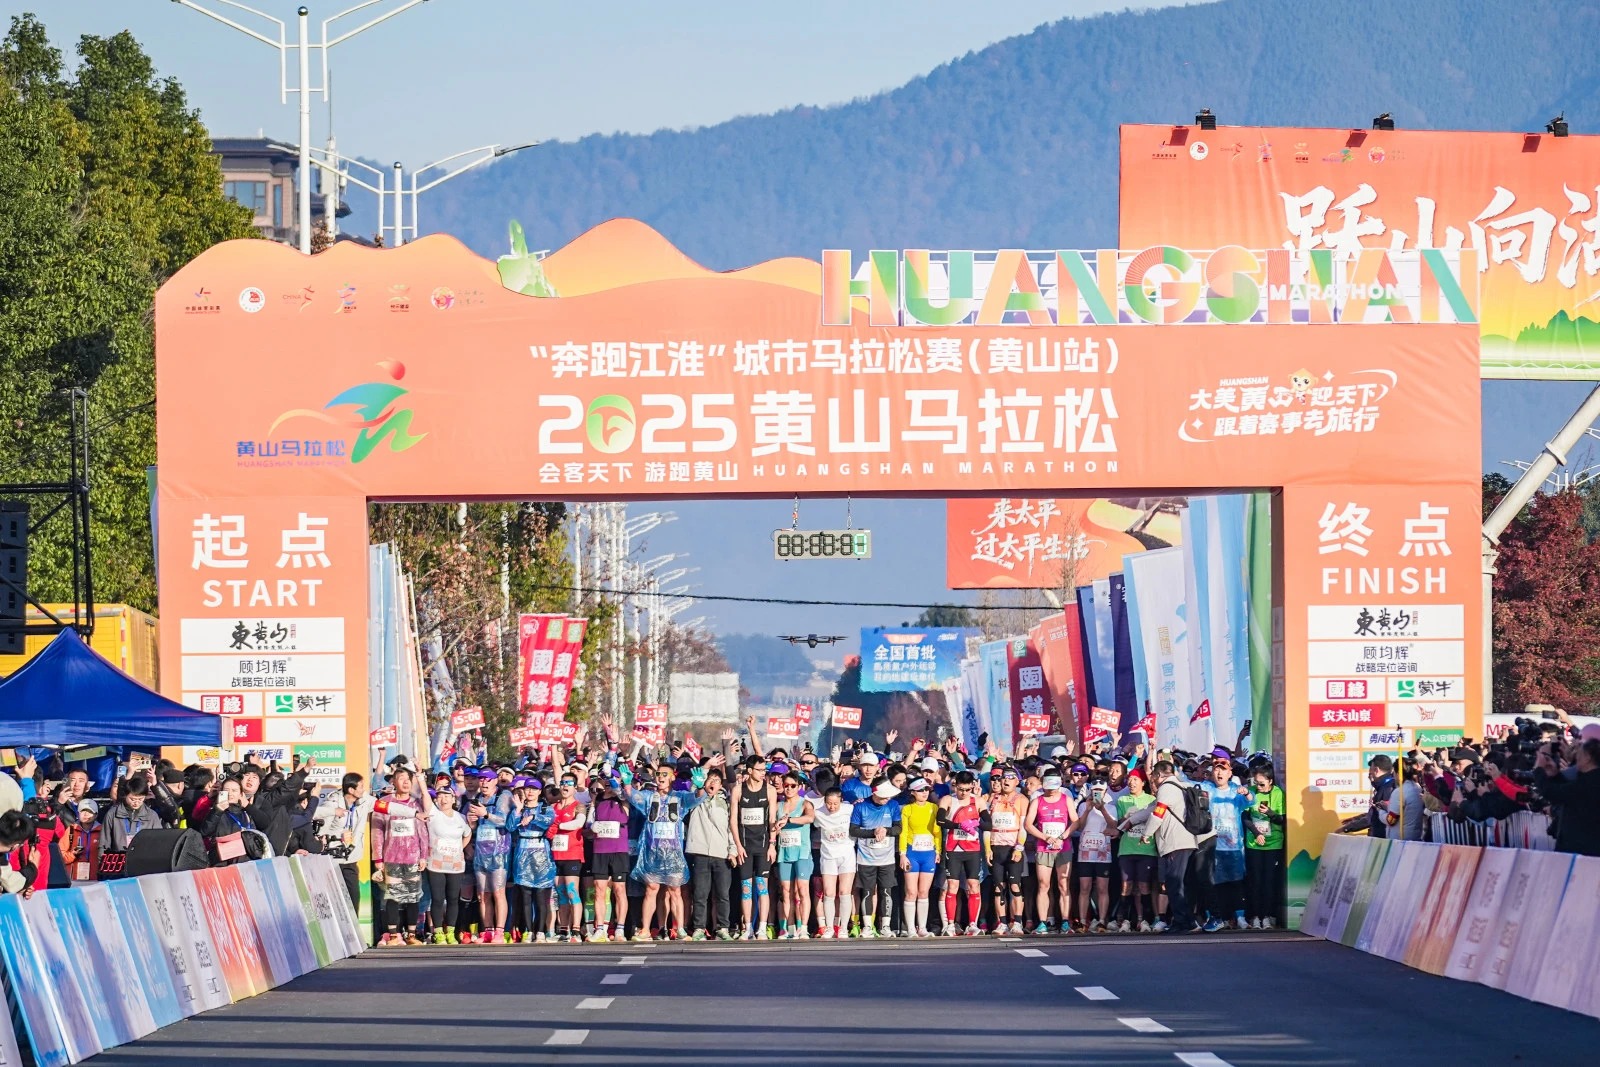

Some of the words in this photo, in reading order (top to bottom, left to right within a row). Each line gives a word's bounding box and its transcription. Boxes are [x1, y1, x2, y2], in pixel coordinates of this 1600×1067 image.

[822, 245, 1480, 325] HUANGSHAN
[1269, 283, 1403, 300] MARATHON
[1219, 376, 1269, 387] HUANGSHAN
[1214, 405, 1380, 437] 跟着赛事去旅行
[236, 440, 346, 457] 黄山马拉松
[237, 460, 293, 468] HUANGSHAN
[538, 462, 633, 482] 会客天下
[644, 461, 738, 482] 游跑黄山
[753, 462, 934, 476] HUANGSHAN
[958, 460, 1119, 474] MARATHON
[974, 498, 1062, 535] 来太平
[1317, 501, 1453, 557] 终点
[192, 512, 332, 570] 起点
[971, 533, 1094, 576] 过太平生活
[1321, 566, 1447, 595] FINISH
[202, 579, 323, 608] START
[874, 644, 936, 661] 全国首批
[1363, 645, 1409, 660] 顾均辉
[239, 659, 287, 674] 顾均辉
[1355, 662, 1418, 673] 战略定位咨询
[231, 676, 296, 688] 战略定位咨询
[1418, 680, 1452, 698] 蒙牛
[297, 694, 332, 712] 蒙牛
[835, 710, 860, 721] 14:00
[1021, 718, 1048, 728] 14:30
[1091, 711, 1119, 725] 15:30
[1322, 708, 1372, 723] 农夫山泉
[769, 722, 797, 732] 14:00
